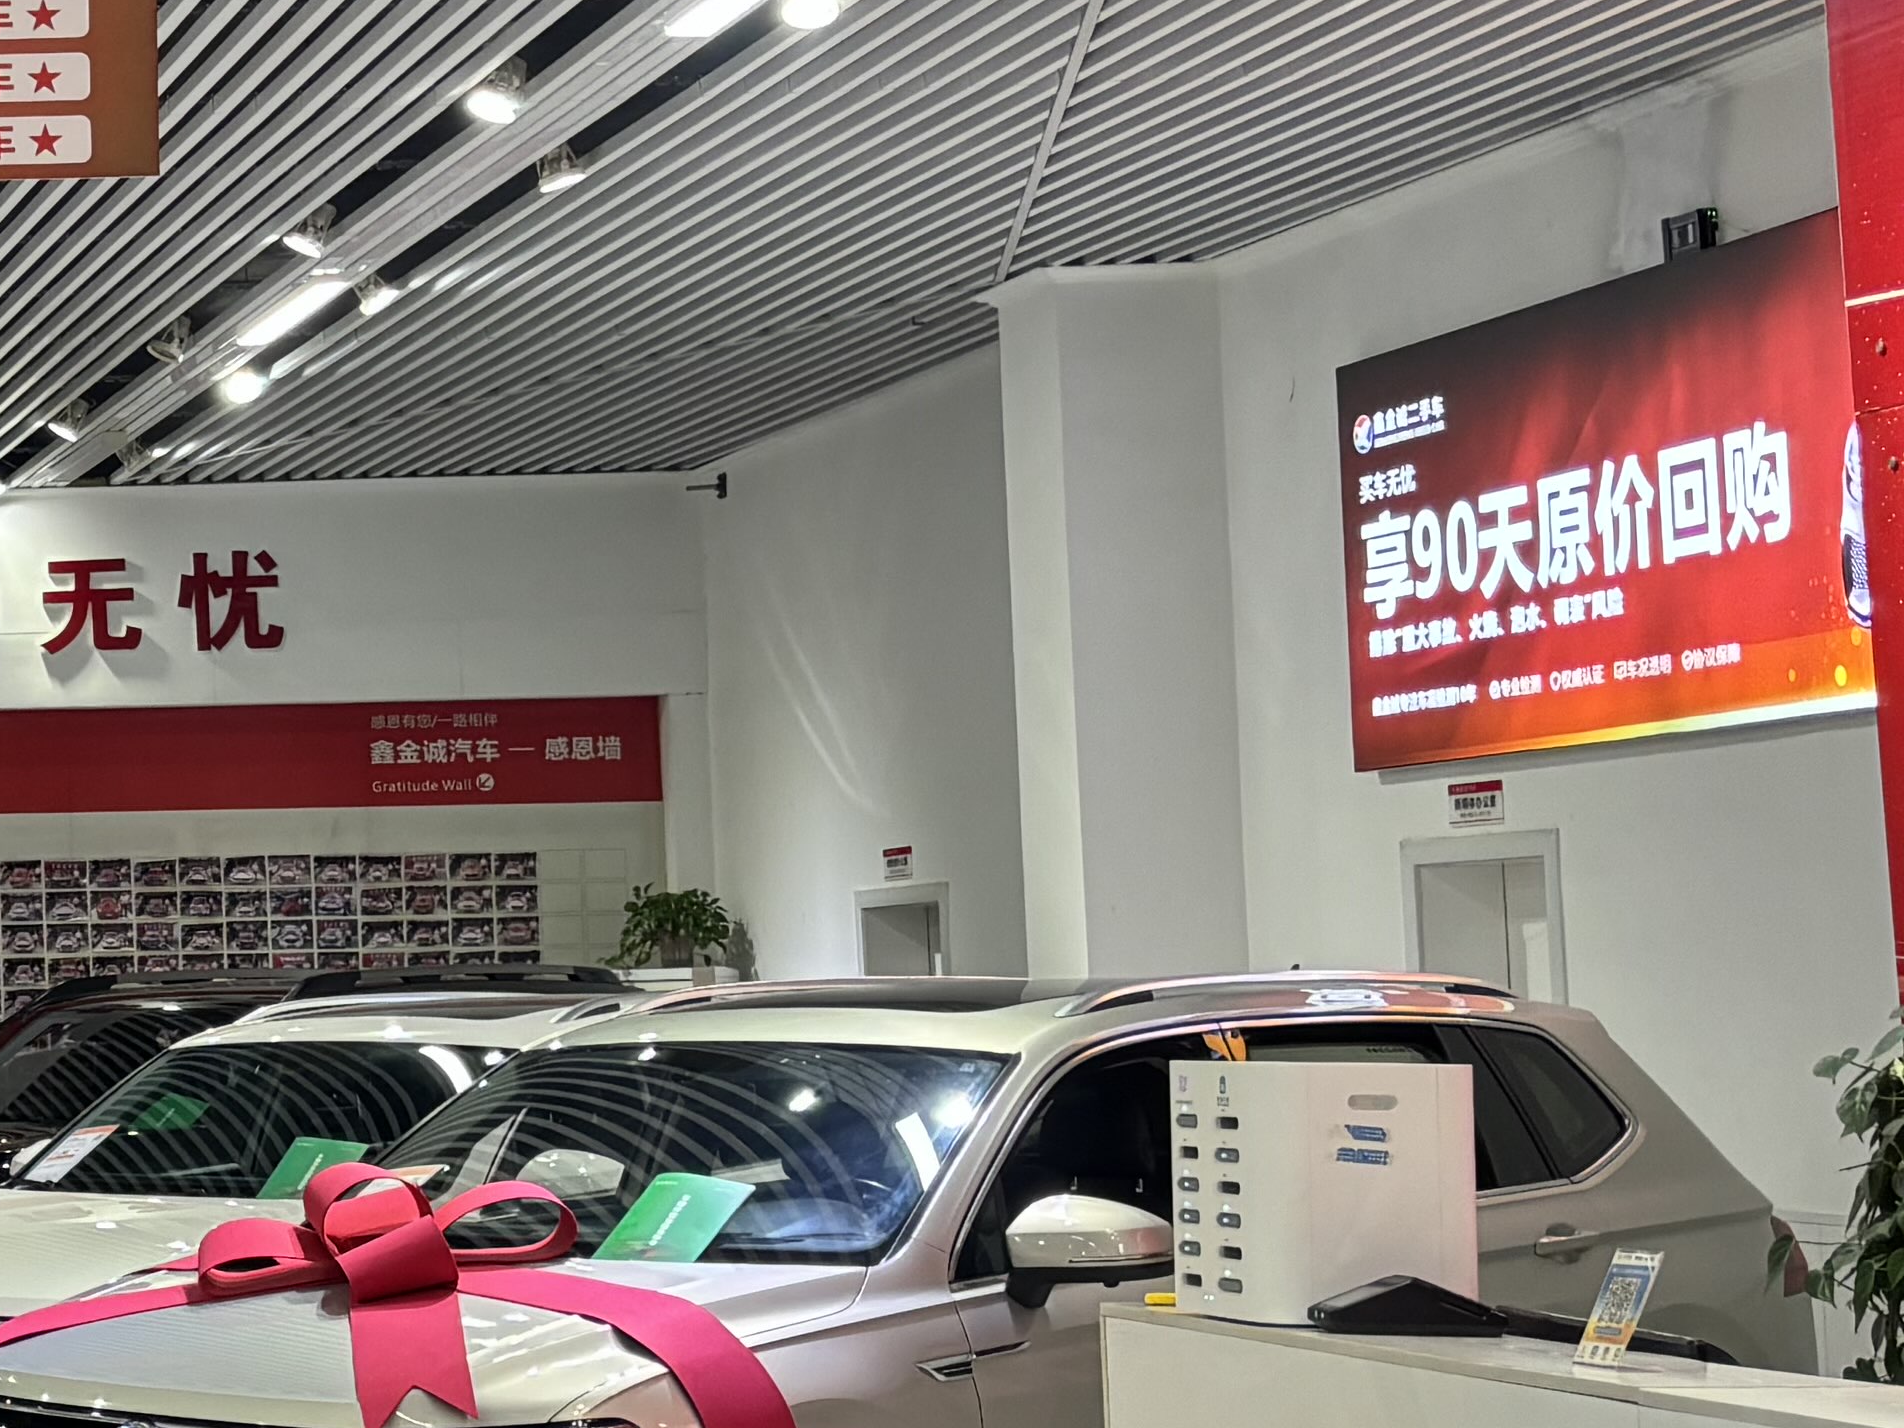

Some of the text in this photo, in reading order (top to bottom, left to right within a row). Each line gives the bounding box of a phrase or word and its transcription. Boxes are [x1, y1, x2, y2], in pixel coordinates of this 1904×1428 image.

[1359, 464, 1417, 504] 买车无忧
[1360, 421, 1792, 620] 享90天原价回购
[370, 737, 501, 765] 鑫金诚汽车
[545, 735, 622, 761] 感恩墙
[372, 778, 472, 793] Gratitude Wall
